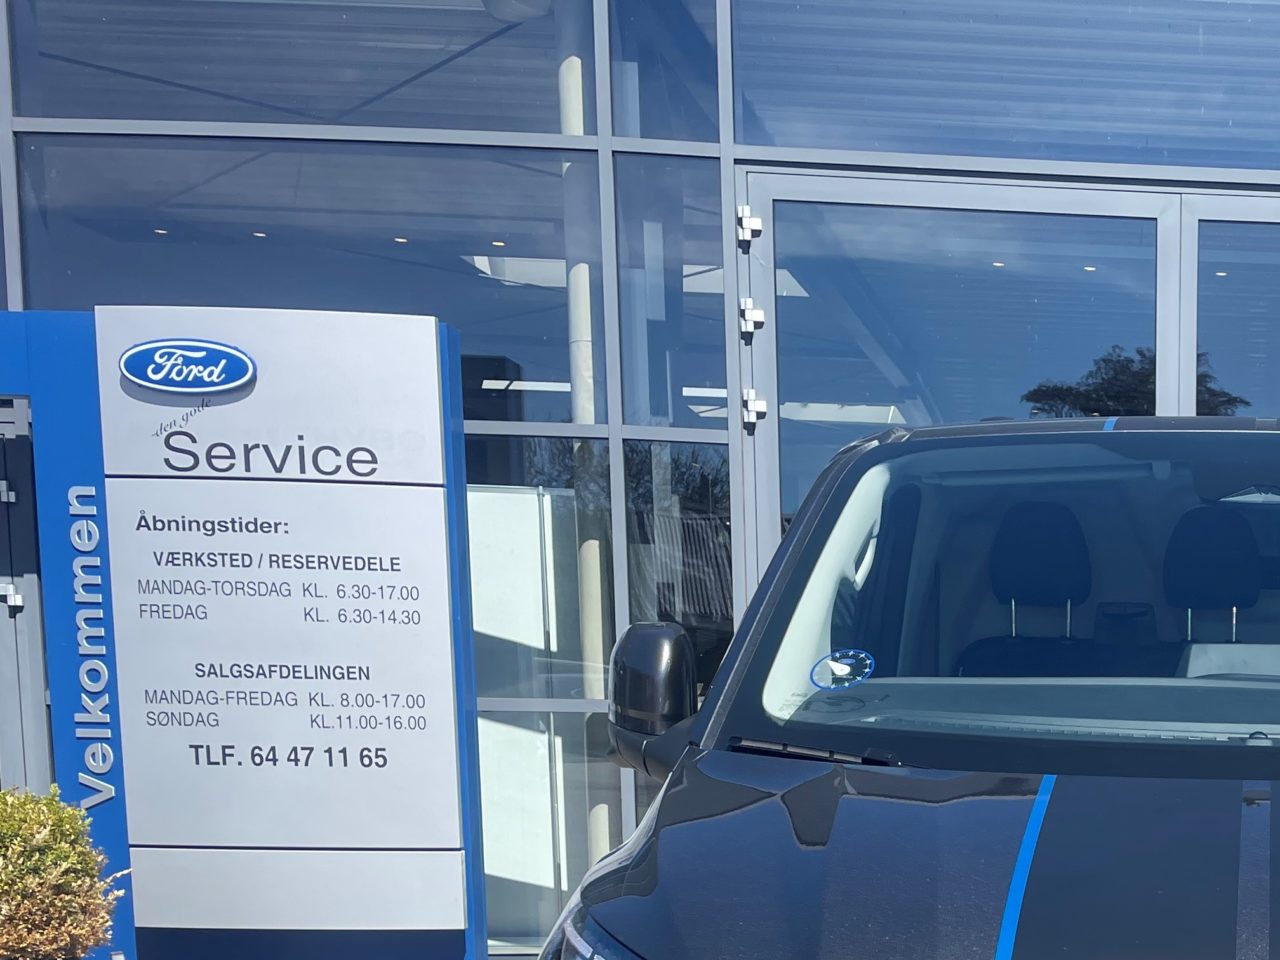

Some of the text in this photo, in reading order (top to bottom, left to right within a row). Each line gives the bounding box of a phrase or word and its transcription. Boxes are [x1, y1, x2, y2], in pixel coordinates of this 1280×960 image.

[146, 348, 227, 383] Ford
[163, 430, 379, 477] Service
[135, 509, 290, 537] Åbningstider:
[153, 551, 253, 568] VÆRKSTED
[268, 554, 402, 572] RESERVEDELE
[137, 579, 420, 601] MANDAG-TORSDAG KL. 6.30-17.00
[139, 604, 421, 625] FREDAG KL. 6.30-14.30
[68, 484, 116, 809] Velkommen
[194, 663, 371, 681] SALGSAFDELINGEN
[144, 689, 426, 709] MANDAG-FREDAG KL. 8.00-17.00
[146, 711, 220, 728] SØNDAG
[188, 744, 388, 768] TLF. 64 47 11 65
